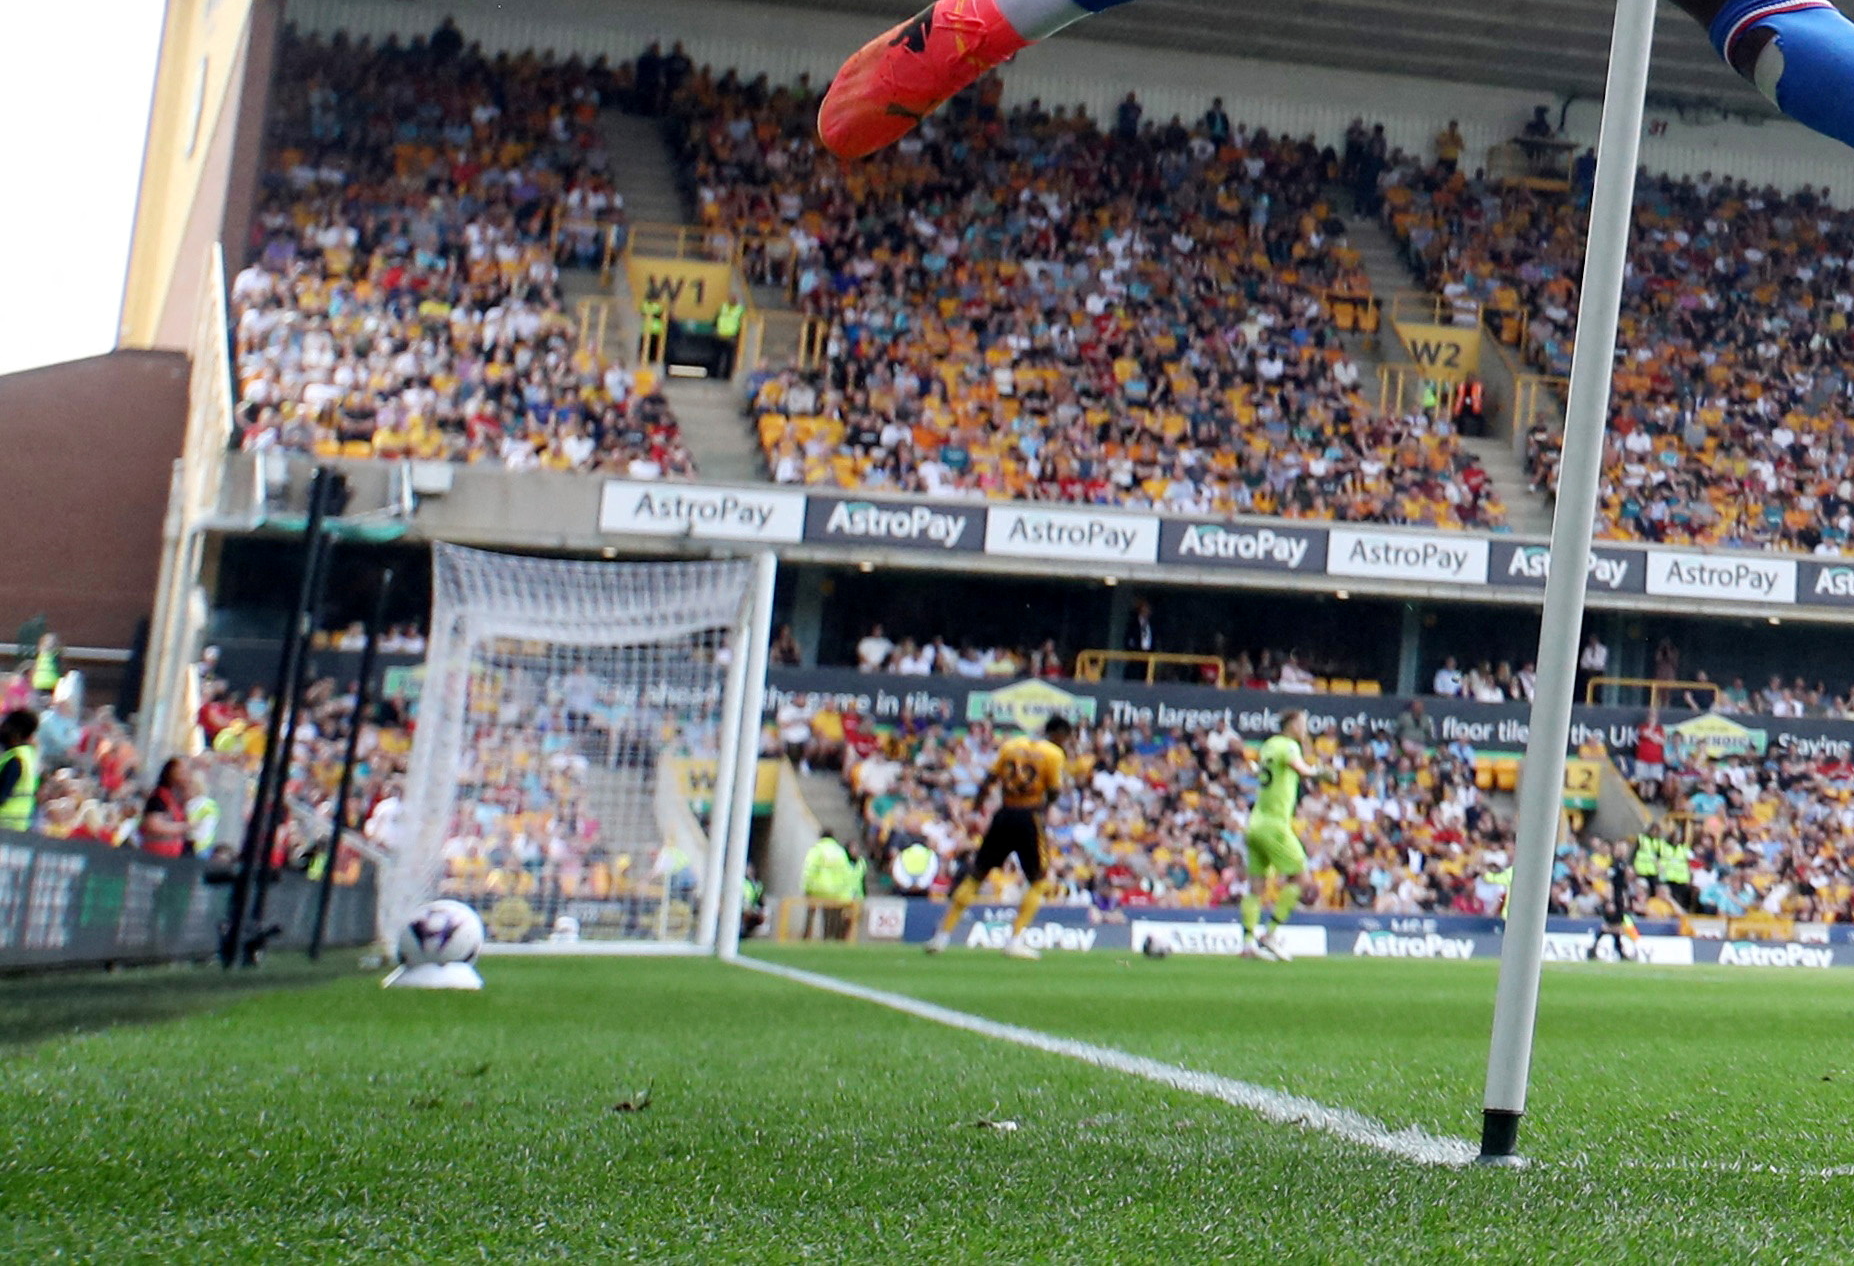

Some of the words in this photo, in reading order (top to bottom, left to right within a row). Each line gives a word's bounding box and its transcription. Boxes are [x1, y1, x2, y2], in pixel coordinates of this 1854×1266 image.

[648, 274, 707, 305] W1
[1411, 338, 1461, 368] W2
[634, 493, 774, 527] AstroPay
[826, 500, 966, 548] AstroPay
[1009, 514, 1137, 553] AstroPay
[1178, 524, 1308, 568] AstroPay
[1349, 538, 1467, 573] AstroPay
[1508, 547, 1627, 589] AstPay
[1666, 559, 1778, 595] AstroPay
[876, 688, 900, 716] in
[1110, 699, 1153, 725] The
[1442, 715, 1492, 743] floor
[1499, 717, 1531, 744] tile
[1564, 768, 1593, 791] L2
[1352, 931, 1476, 960] AstroPay
[1718, 941, 1835, 968] AstroPay
